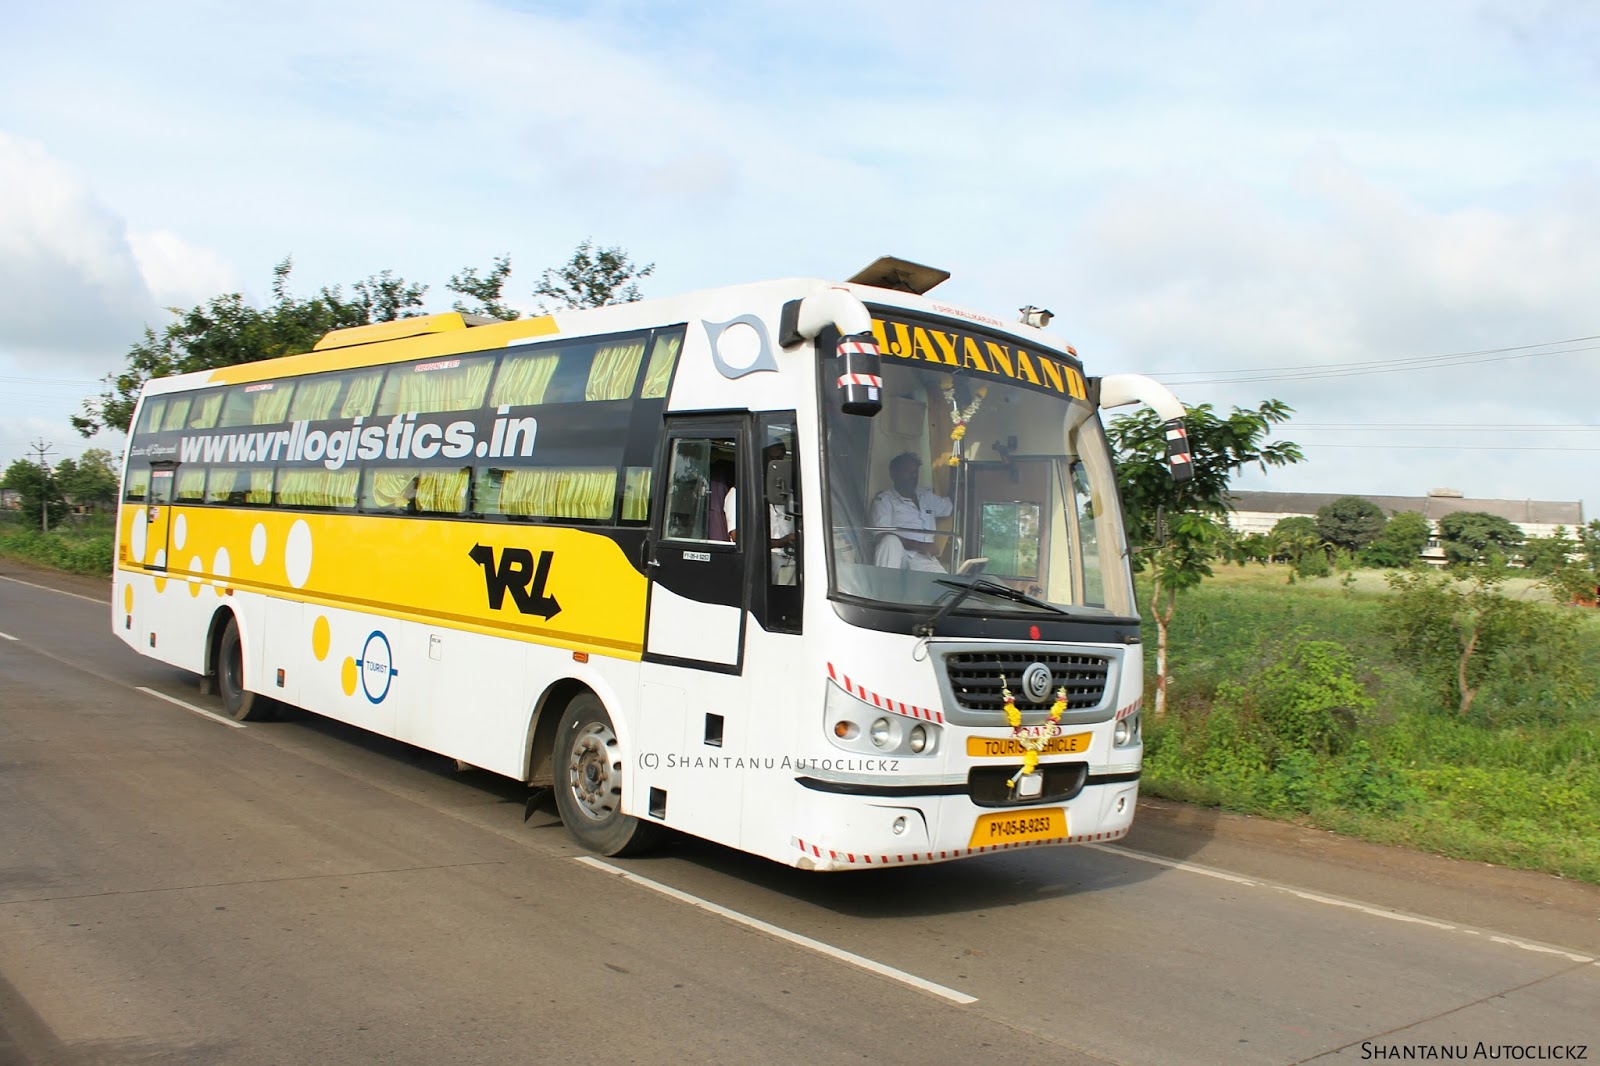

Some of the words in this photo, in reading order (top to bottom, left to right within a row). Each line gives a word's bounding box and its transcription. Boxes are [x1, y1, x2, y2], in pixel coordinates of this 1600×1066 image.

[836, 317, 1087, 401] IJAYANAND
[181, 404, 537, 470] www.vrllogistics.in
[468, 541, 562, 622] VRL
[366, 660, 387, 674] TOURIST
[985, 740, 1026, 755] TOURIS
[1040, 739, 1077, 753] EHICLE
[990, 816, 1050, 838] PY-05-B-9253
